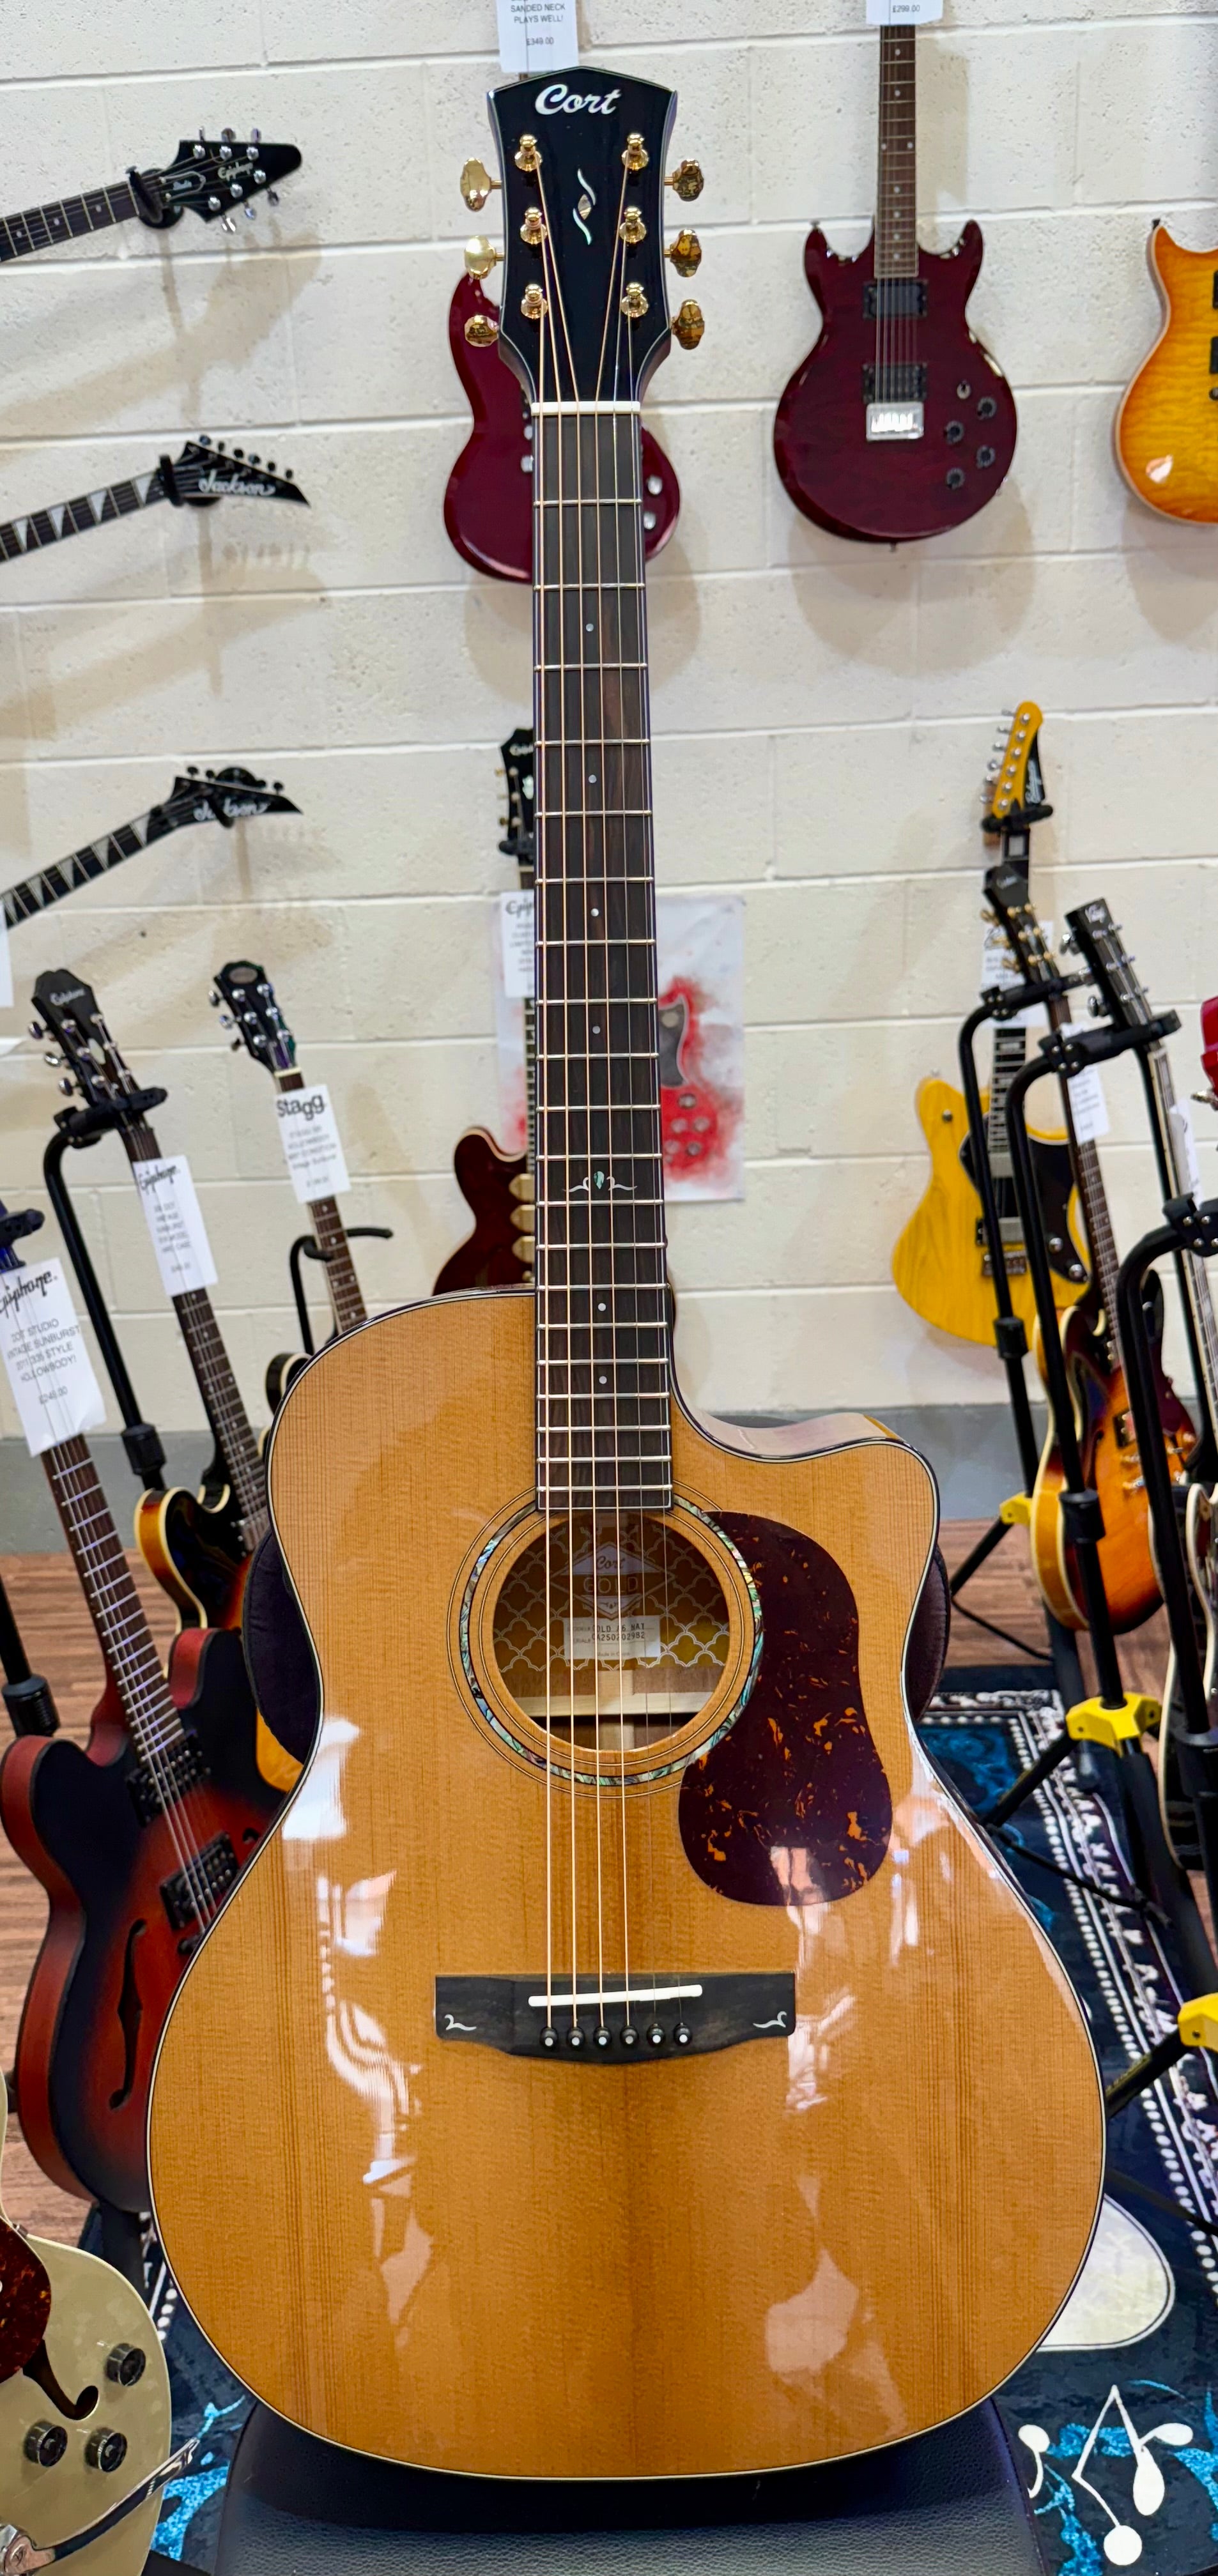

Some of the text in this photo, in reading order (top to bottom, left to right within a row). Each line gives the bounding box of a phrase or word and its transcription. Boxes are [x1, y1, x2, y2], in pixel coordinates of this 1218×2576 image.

[511, 4, 543, 13] SANDED
[892, 4, 920, 13] £299.00
[514, 15, 539, 24] PLAYS
[534, 83, 622, 115] Cort
[198, 468, 275, 495] Jackson
[193, 797, 269, 821] Jakson
[277, 1094, 325, 1121] stagg
[0, 1270, 52, 1319] piphone
[27, 1318, 59, 1337] STUDIO
[33, 1324, 80, 1349] SUNBURST
[45, 1341, 73, 1359] STYLE
[583, 1576, 638, 1594] GOLD
[631, 1623, 645, 1631] NAT
